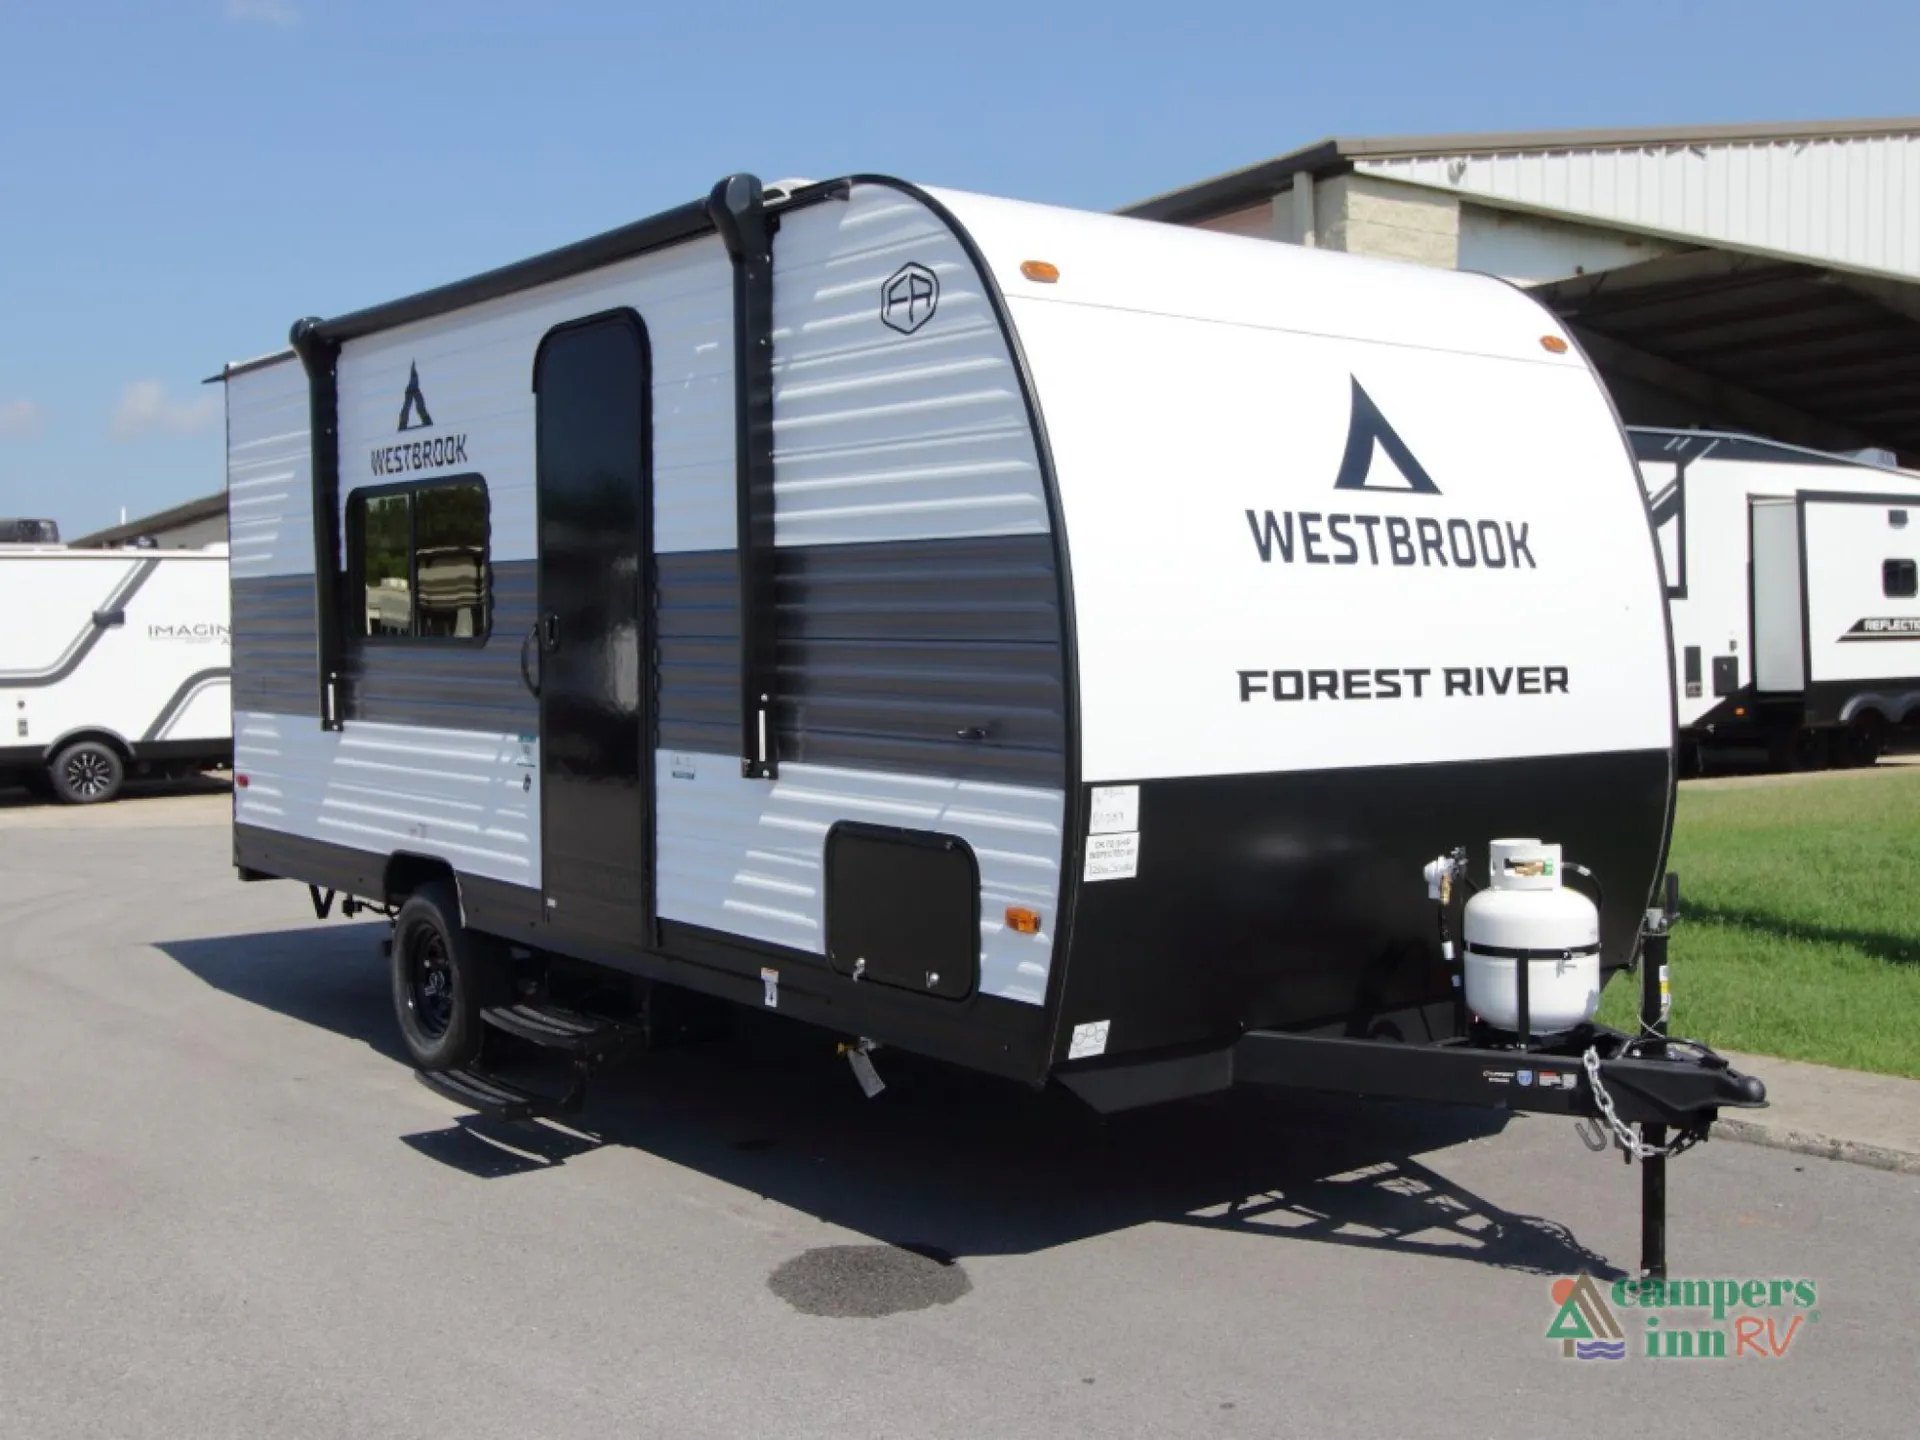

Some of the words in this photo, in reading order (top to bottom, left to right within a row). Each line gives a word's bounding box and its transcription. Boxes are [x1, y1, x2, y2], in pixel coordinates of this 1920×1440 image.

[371, 433, 468, 476] WESTBROOK
[1245, 509, 1537, 569] WESTBROOK
[1236, 667, 1431, 702] FOREST
[1442, 665, 1569, 697] RIVER
